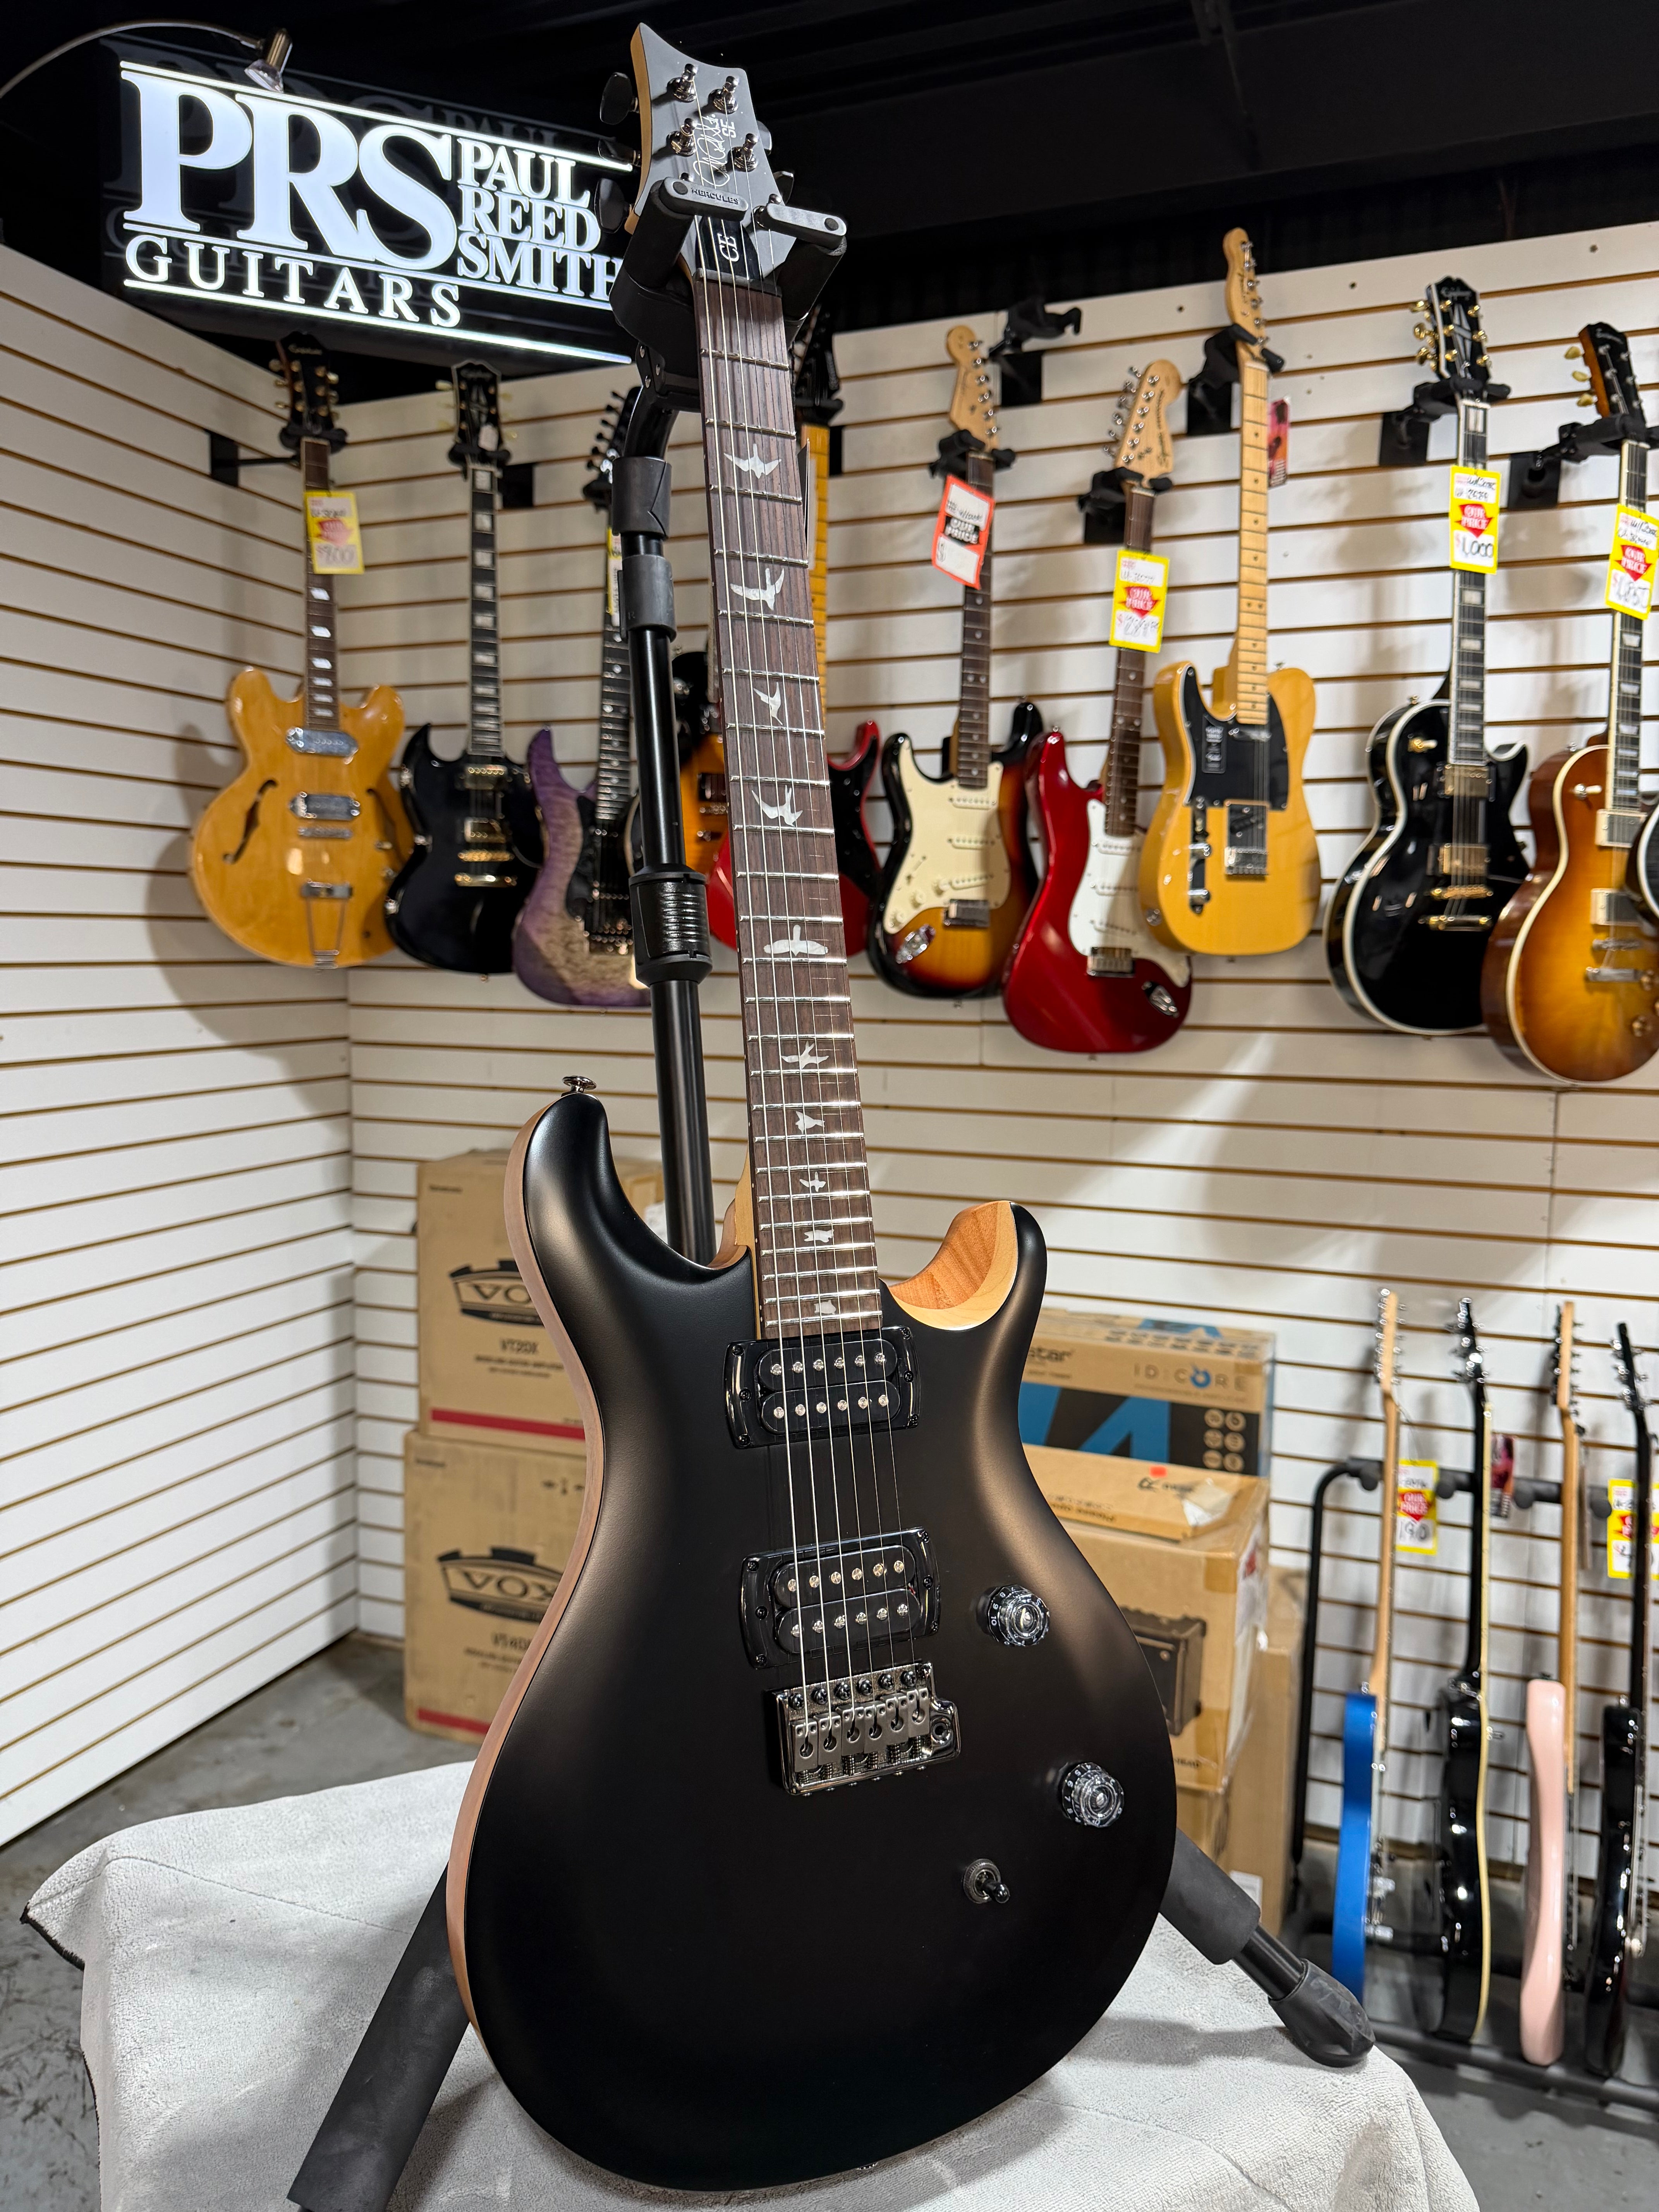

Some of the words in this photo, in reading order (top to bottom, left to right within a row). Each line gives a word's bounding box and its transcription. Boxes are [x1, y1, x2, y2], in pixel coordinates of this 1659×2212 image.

[122, 70, 457, 270] PRS
[457, 138, 590, 208] PAUL
[691, 187, 740, 205] HERCULES
[458, 185, 601, 252] REED
[125, 236, 461, 328] GUITARS
